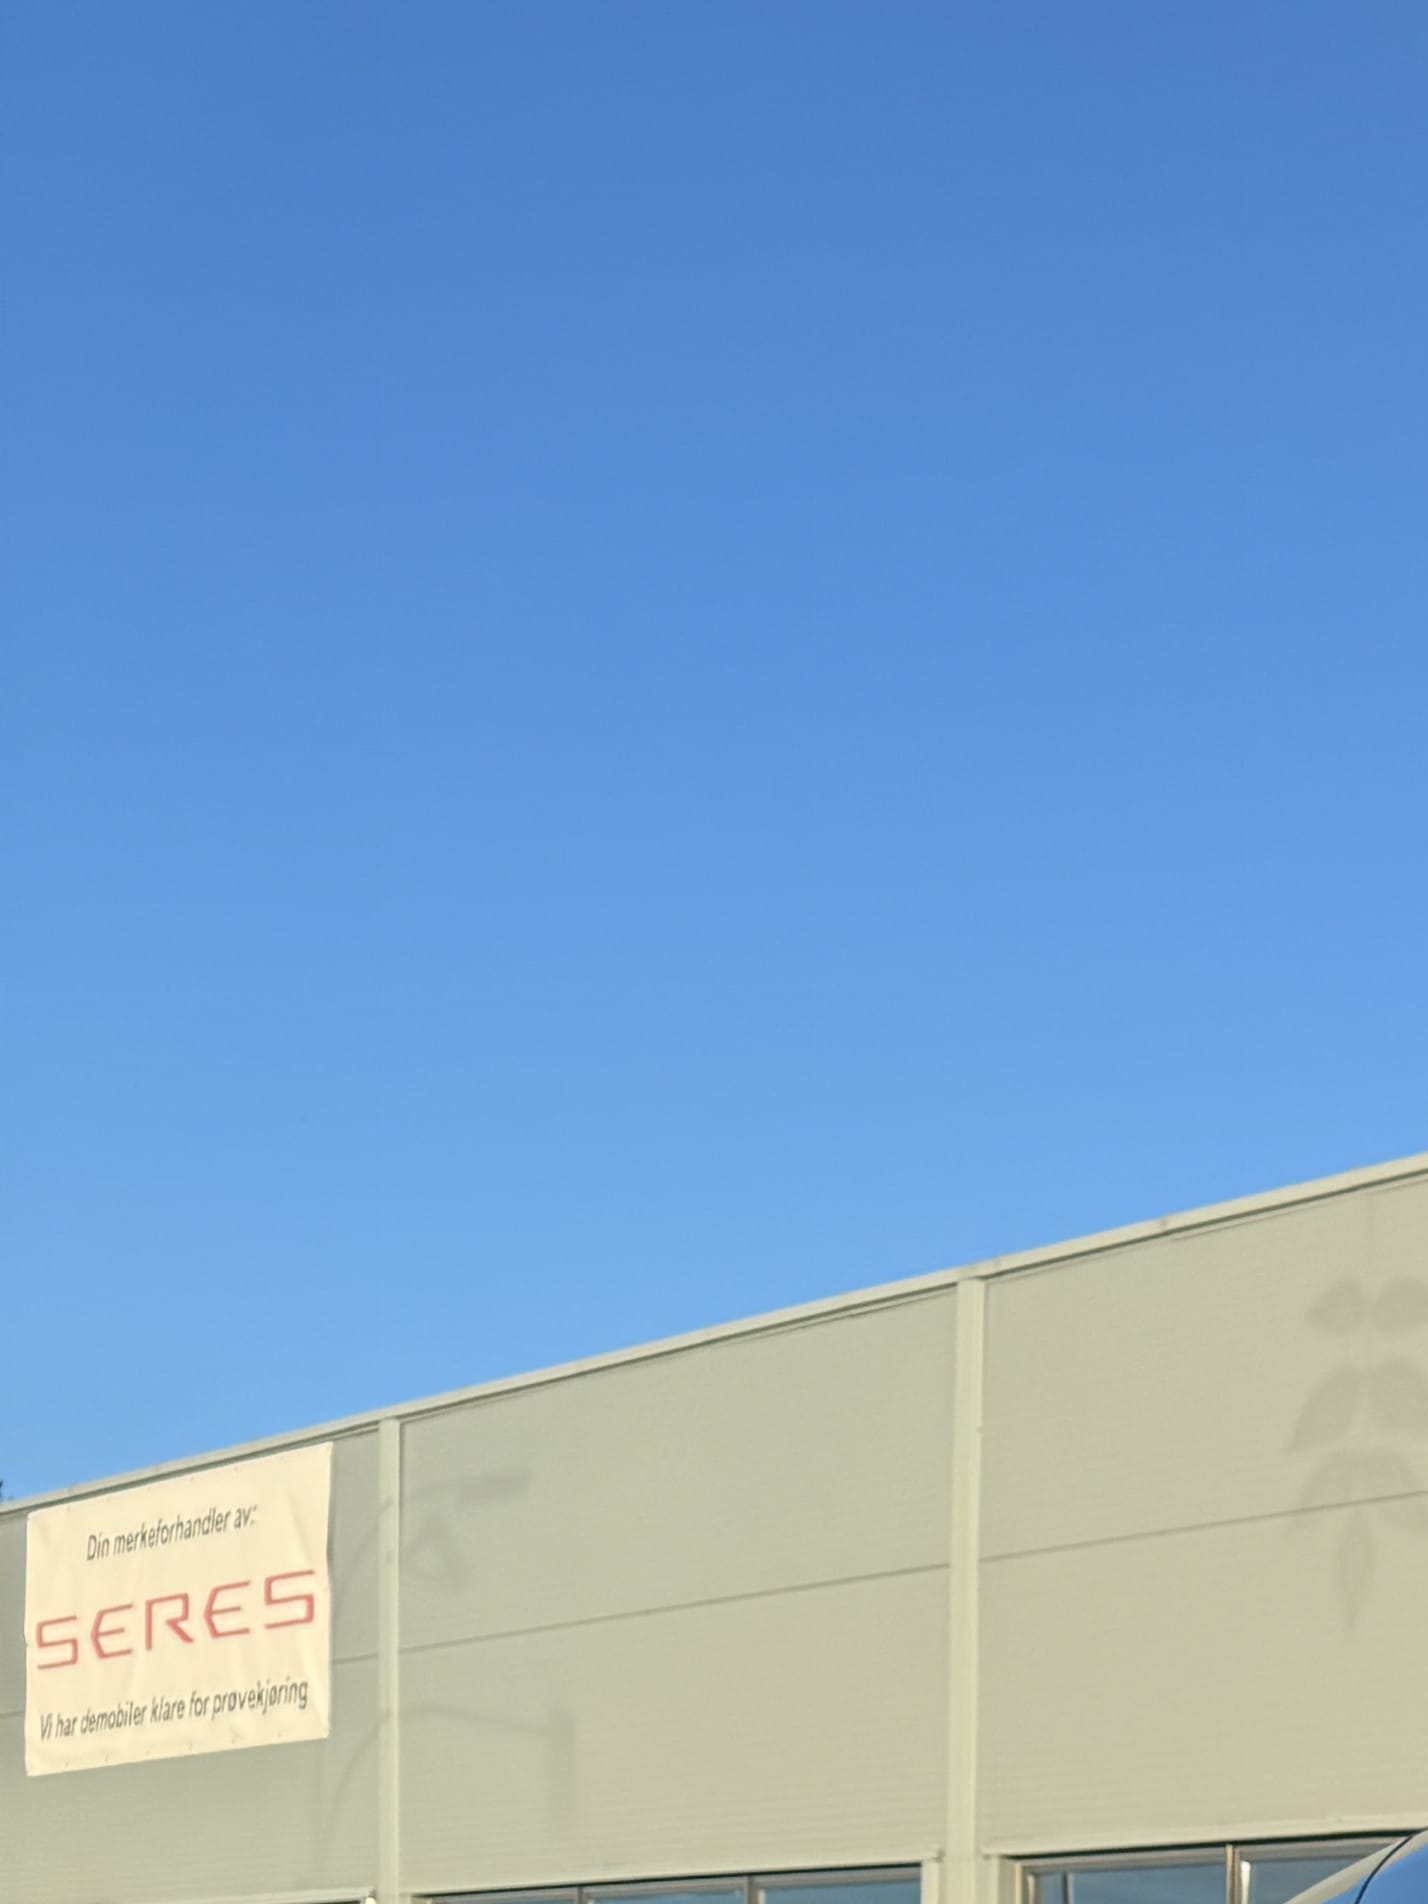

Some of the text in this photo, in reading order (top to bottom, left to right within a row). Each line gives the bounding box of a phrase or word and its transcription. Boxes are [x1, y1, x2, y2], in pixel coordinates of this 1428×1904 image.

[86, 1505, 257, 1561] Din merkeforhandler av:
[35, 1569, 316, 1671] SERES
[40, 1676, 309, 1742] Vi har demobiler klare for prøvekjøring
